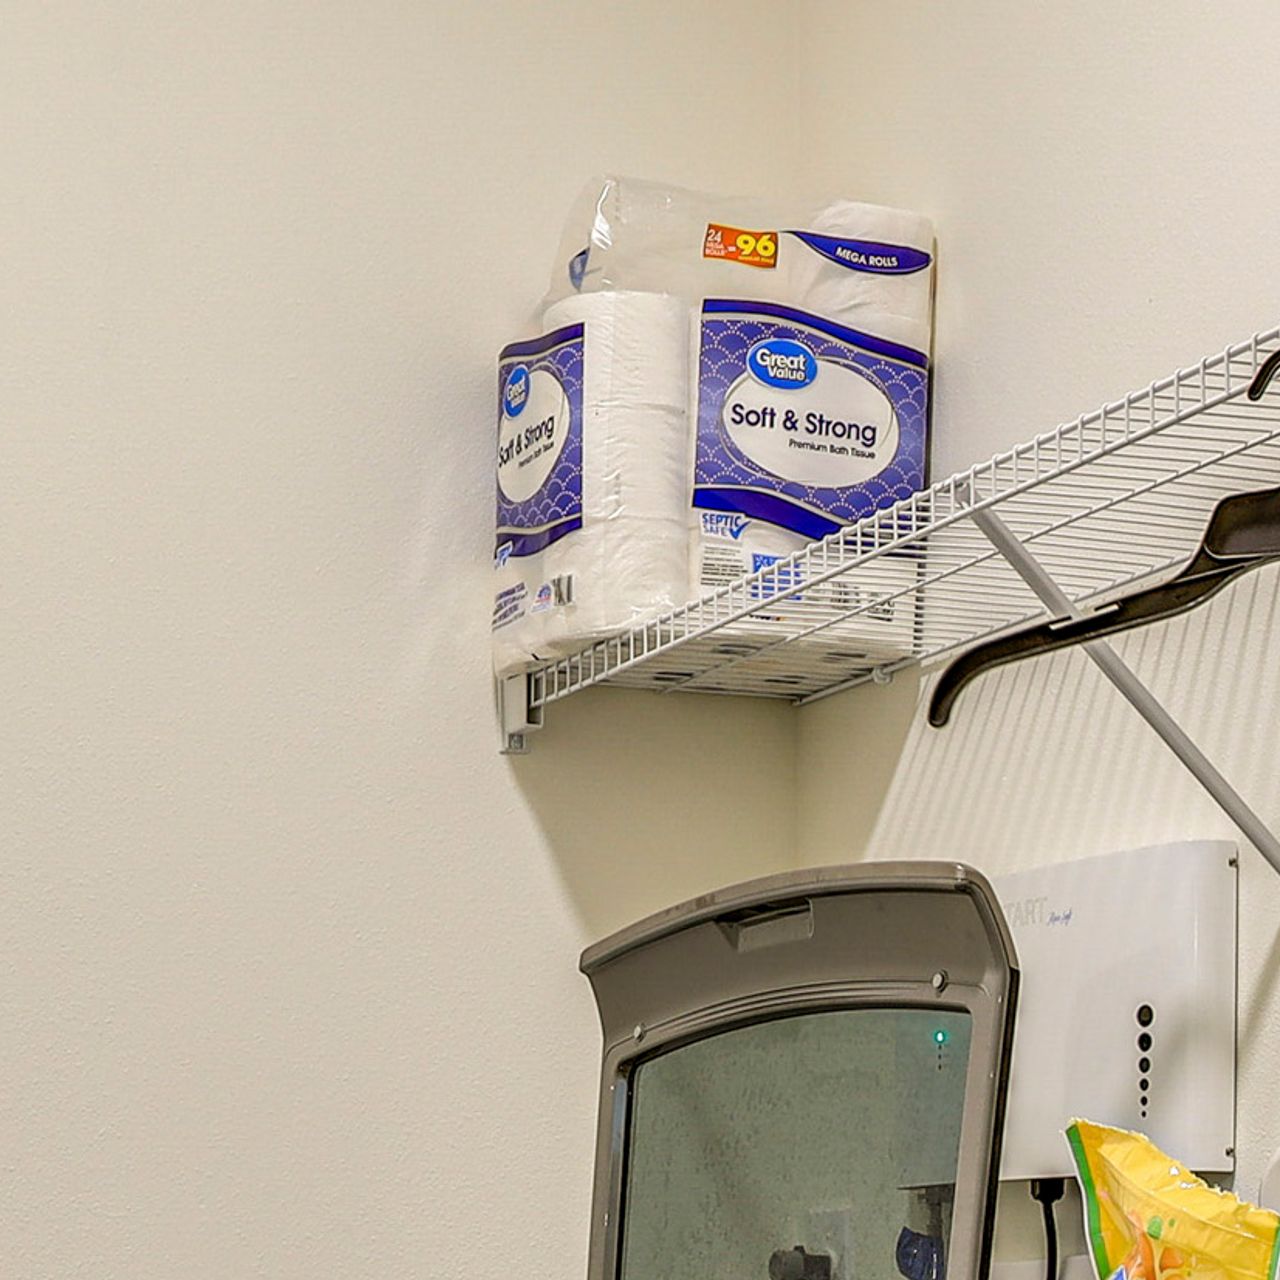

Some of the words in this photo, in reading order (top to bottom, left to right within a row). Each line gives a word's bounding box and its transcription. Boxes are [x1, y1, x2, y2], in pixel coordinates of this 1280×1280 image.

[708, 229, 722, 242] 24
[736, 233, 776, 256] 96
[835, 247, 867, 266] MEGA
[869, 253, 898, 267] ROLLS
[756, 348, 806, 370] Great
[768, 366, 805, 381] Value
[524, 416, 555, 447] Strong
[731, 403, 776, 427] Soft
[783, 410, 798, 431] &
[805, 413, 877, 448] Strong
[788, 439, 827, 452] Premium
[829, 445, 849, 455] Bath
[851, 448, 876, 459] Tissue
[702, 513, 742, 527] SEPTIC
[703, 525, 727, 537] SAFE
